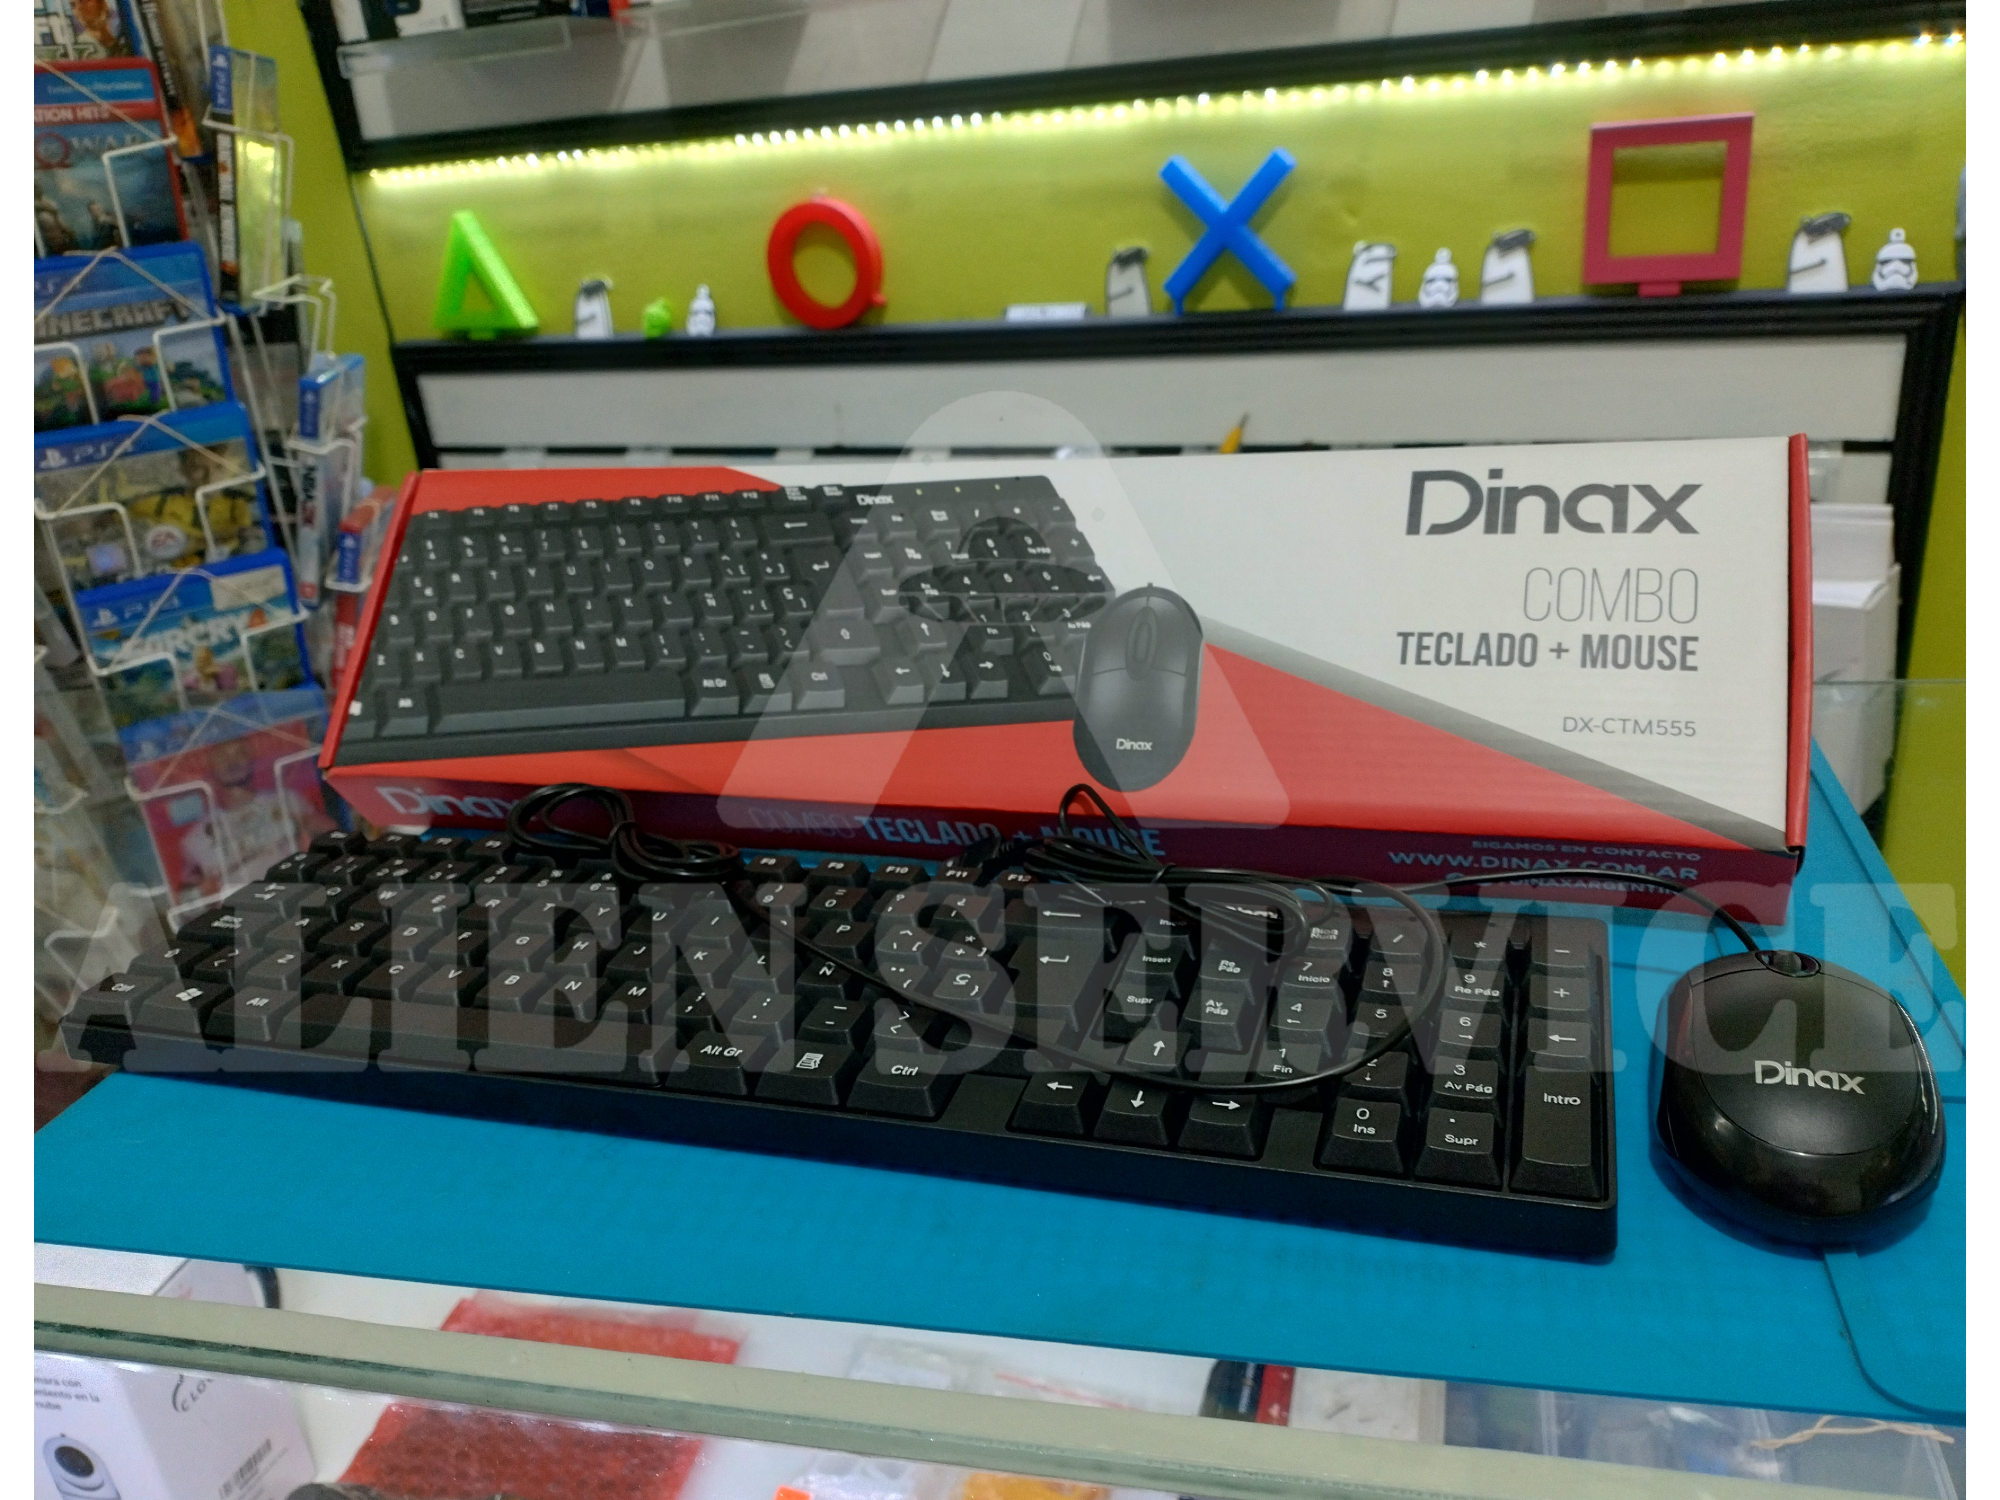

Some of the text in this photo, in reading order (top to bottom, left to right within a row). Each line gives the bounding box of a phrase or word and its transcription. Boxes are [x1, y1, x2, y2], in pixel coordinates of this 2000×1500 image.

[856, 494, 894, 506] Dinax
[1405, 469, 1704, 536] Dinax
[645, 560, 654, 570] O
[567, 566, 576, 575] U
[1523, 567, 1699, 624] COMBO
[1022, 611, 1031, 621] 2
[1397, 632, 1699, 671] TECLADO + MOUSE
[1562, 716, 1697, 737] DX-CTM555
[1116, 738, 1153, 751] Dinax
[854, 816, 1000, 847] TECLADO
[1471, 840, 1701, 861] SIGAMOS EN CONTACTO
[598, 907, 610, 915] Y
[653, 912, 666, 921] U
[837, 925, 850, 933] P
[573, 941, 588, 949] H
[694, 952, 707, 960] K
[757, 956, 765, 964] L
[332, 960, 348, 968] X
[1303, 962, 1312, 971] 7
[389, 965, 404, 974] C
[448, 969, 462, 978] V
[1383, 968, 1393, 976] 8
[505, 975, 520, 984] B
[1465, 975, 1476, 983] 9
[565, 981, 581, 990] N
[1455, 986, 1471, 994] Re
[628, 987, 646, 996] M
[1127, 996, 1153, 1004] Supr
[1206, 1000, 1222, 1008] Av
[1291, 1003, 1302, 1012] 4
[1375, 1009, 1386, 1018] 5
[1460, 1017, 1471, 1026] 6
[700, 1045, 743, 1056] Alt Gr
[891, 1065, 918, 1075] Ctrl
[1273, 1064, 1292, 1073] Fin
[1454, 1064, 1465, 1075] 3
[1754, 1060, 1866, 1095] Dinax
[1445, 1081, 1492, 1093] Av Pág
[1544, 1093, 1580, 1105] Intro
[1354, 1124, 1375, 1134] Ins
[1445, 1134, 1478, 1145] Supr
